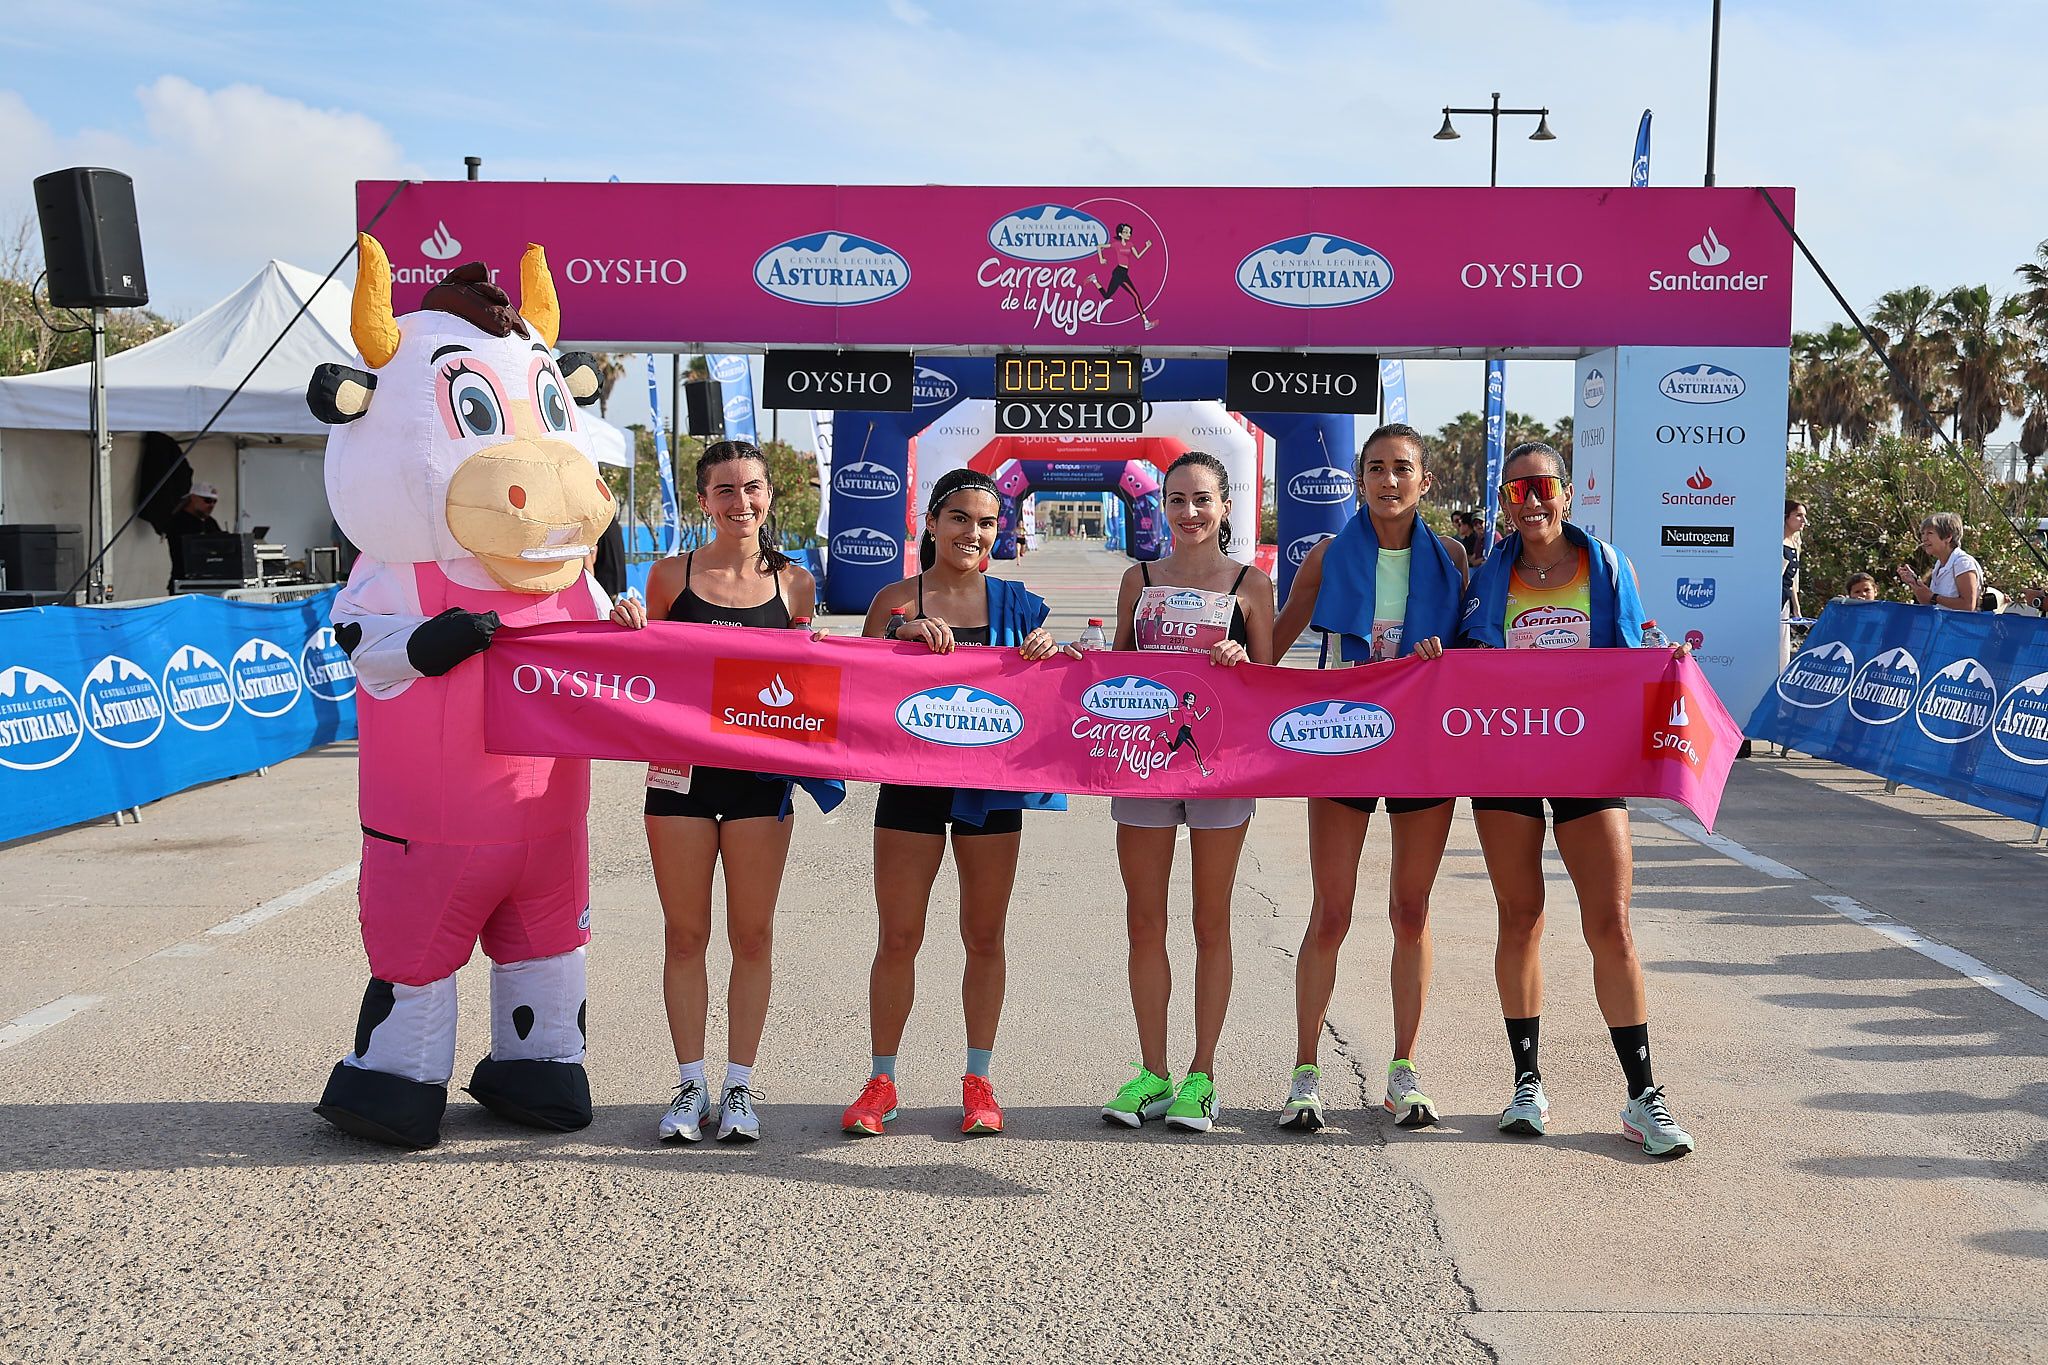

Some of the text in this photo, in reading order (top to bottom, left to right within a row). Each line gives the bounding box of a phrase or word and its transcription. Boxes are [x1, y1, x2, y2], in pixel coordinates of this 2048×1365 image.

[997, 225, 1099, 247] ASTURIANA
[566, 258, 688, 285] OYSHO
[766, 258, 898, 286] ASTURIANA
[790, 257, 838, 265] CENTRAL
[977, 257, 1077, 288] Carrera
[1249, 261, 1381, 288] ASTURIANA
[1460, 263, 1584, 289] OYSHO
[1649, 270, 1768, 291] Santander
[1001, 285, 1113, 336] de la Mujer
[787, 370, 891, 394] OYSHO
[1005, 360, 1132, 391] 00:20:37
[1251, 370, 1357, 396] OYSHO
[1665, 378, 1738, 394] ASTURIANA
[913, 385, 949, 398] RIANA
[1002, 402, 1136, 430] OYSHO
[940, 427, 980, 436] OYSHO
[1191, 426, 1231, 436] OYSHO
[1581, 427, 1605, 448] OYSHO
[1656, 425, 1745, 444] OYSHO
[837, 474, 896, 491] ASTURIANA
[1662, 492, 1736, 506] Santander
[834, 540, 893, 557] ASTURIANA
[1666, 529, 1729, 545] Neutrogena
[1678, 584, 1714, 600] Marlene
[1162, 621, 1197, 636] 016
[1518, 615, 1583, 628] Serrano
[236, 670, 298, 700] ASTURIANA
[512, 664, 657, 704] OYSHO
[1781, 660, 1845, 694] ASTURIANA
[169, 680, 231, 713] ASTURIANA
[1088, 691, 1169, 710] ASTURIANA
[1852, 671, 1911, 709] ASTURIANA
[0, 702, 32, 715] ENTRAL
[90, 693, 161, 730] ASTURIANA
[925, 703, 1010, 715] CENTRAL LECHERA
[1919, 684, 1988, 727] ASTURIANA
[0, 710, 79, 747] STURIANA
[723, 707, 825, 732] Santander
[905, 703, 1013, 733] ASTURIANA
[1071, 716, 1151, 741] Carrera
[1298, 714, 1384, 726] CENTRAL LECHERA
[1441, 707, 1586, 737] OYSHO
[1279, 720, 1385, 743] ASTURIANA
[1089, 739, 1178, 780] de la Mujer
